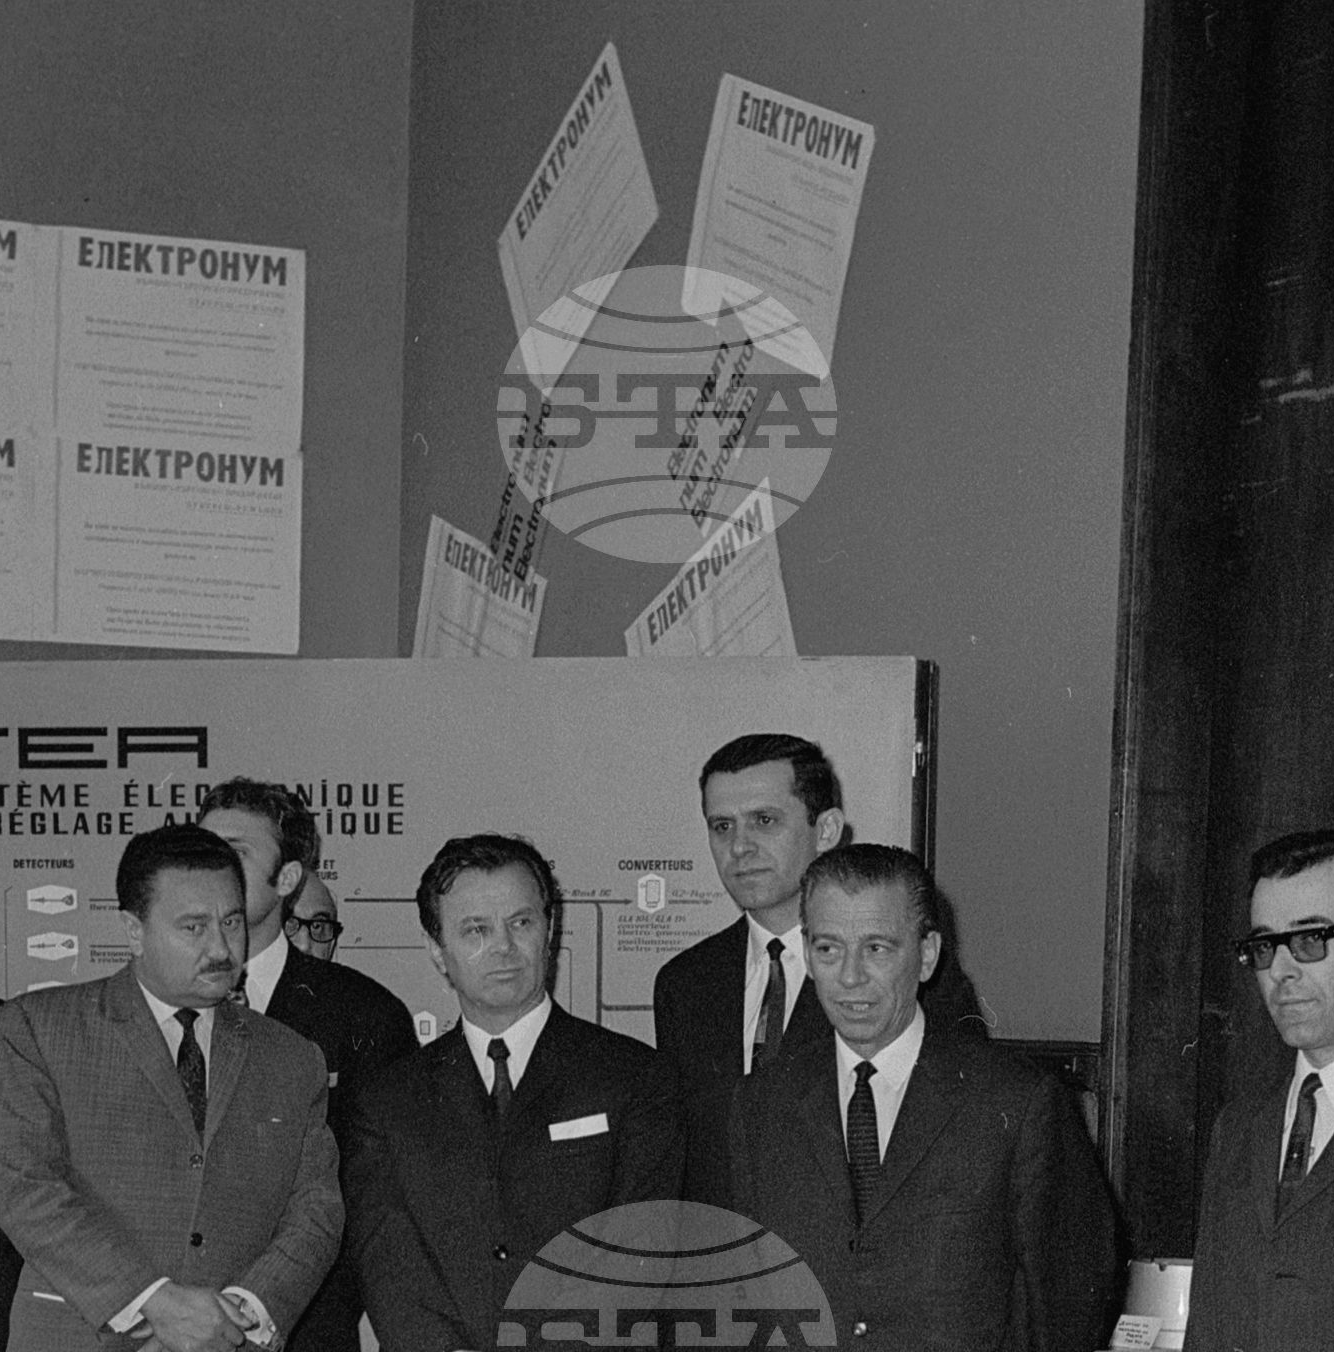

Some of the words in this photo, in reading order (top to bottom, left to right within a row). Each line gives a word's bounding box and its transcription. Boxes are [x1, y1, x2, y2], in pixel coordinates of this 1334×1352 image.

[514, 61, 613, 241] ЕЛЕКТРОНУМ
[737, 91, 864, 170] ЕЛЕКТРОНУМ
[77, 236, 287, 286] ЕЛЕКТРОНУМ
[77, 442, 284, 488] ЕЛЕКТРОНУМ
[647, 498, 764, 647] ЕЛЕКТРОНУМ
[12, 858, 75, 870] DETECTEURS
[618, 859, 694, 872] CONVERTEURS
